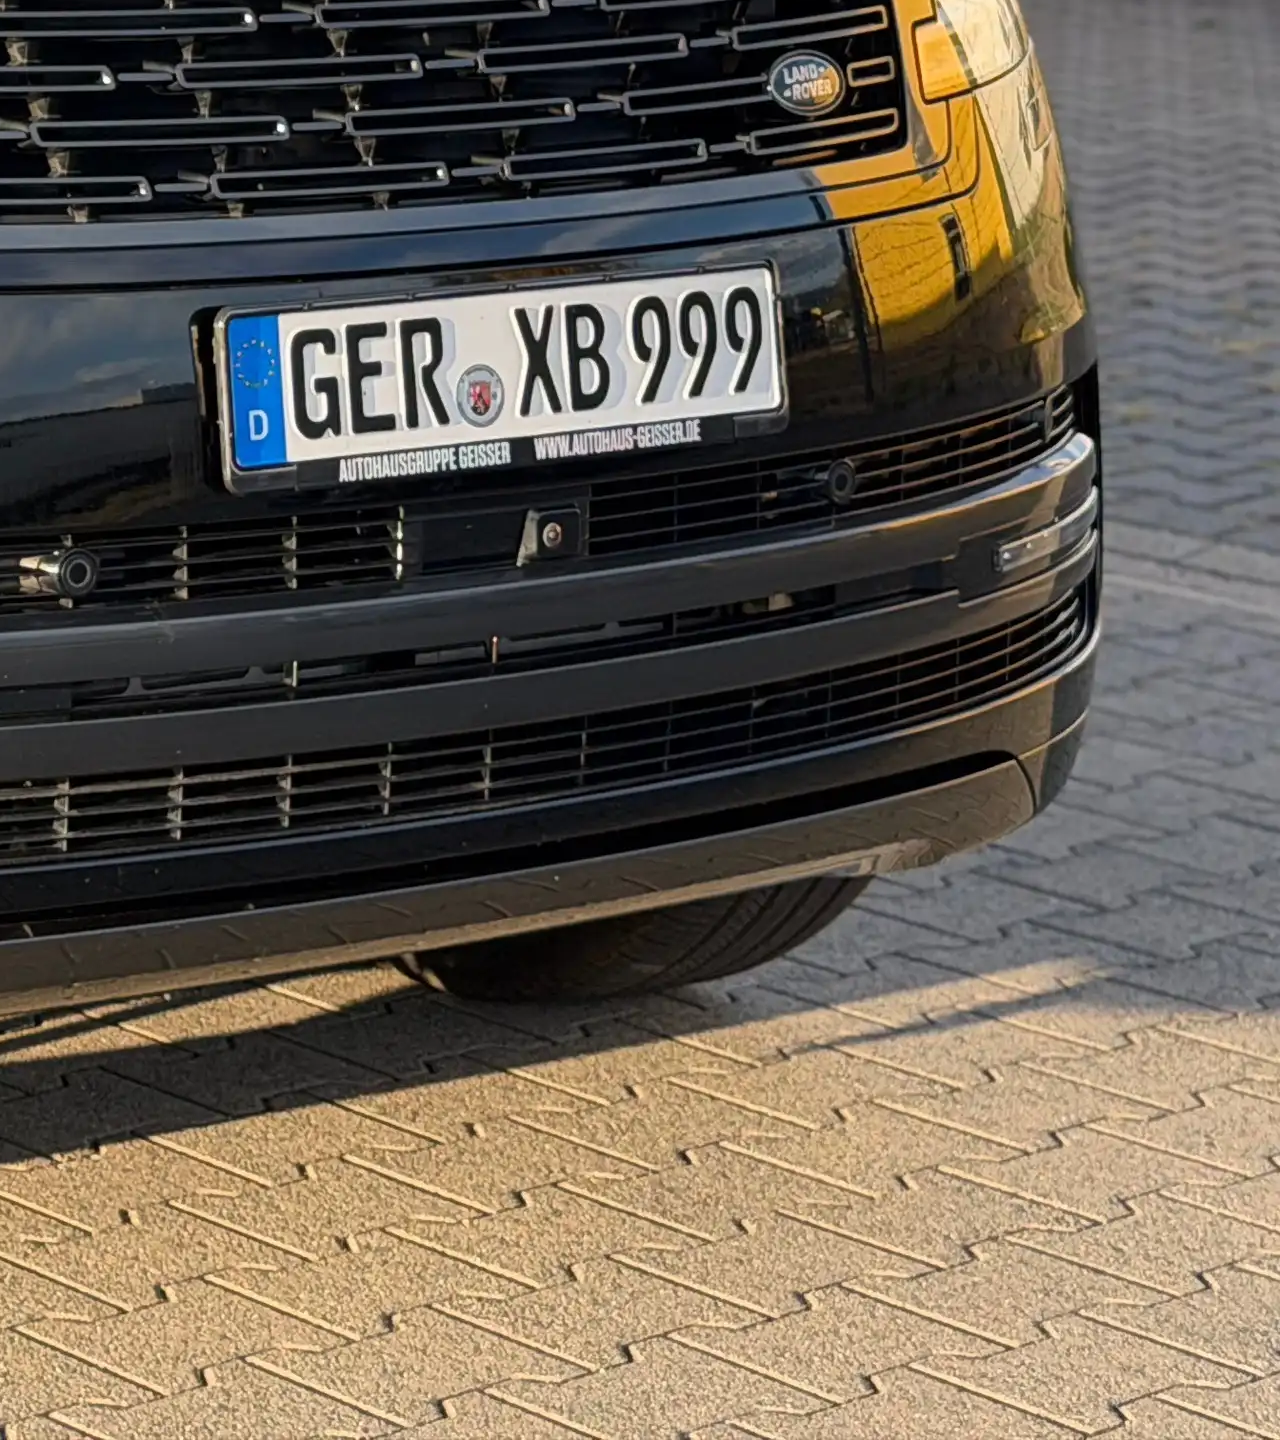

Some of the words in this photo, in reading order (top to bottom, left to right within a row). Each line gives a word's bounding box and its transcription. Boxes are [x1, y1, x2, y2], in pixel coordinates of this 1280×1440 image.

[783, 64, 818, 84] LAND
[793, 78, 832, 100] ROVER
[290, 316, 450, 439] GER
[515, 303, 611, 417] XB
[631, 287, 763, 404] 999
[249, 409, 269, 442] D
[338, 448, 457, 483] AUTOHAUSGRUPPE
[458, 441, 512, 469] GEISSER
[534, 418, 701, 460] WWW.AUTOHAUS-GEISSER.DE
